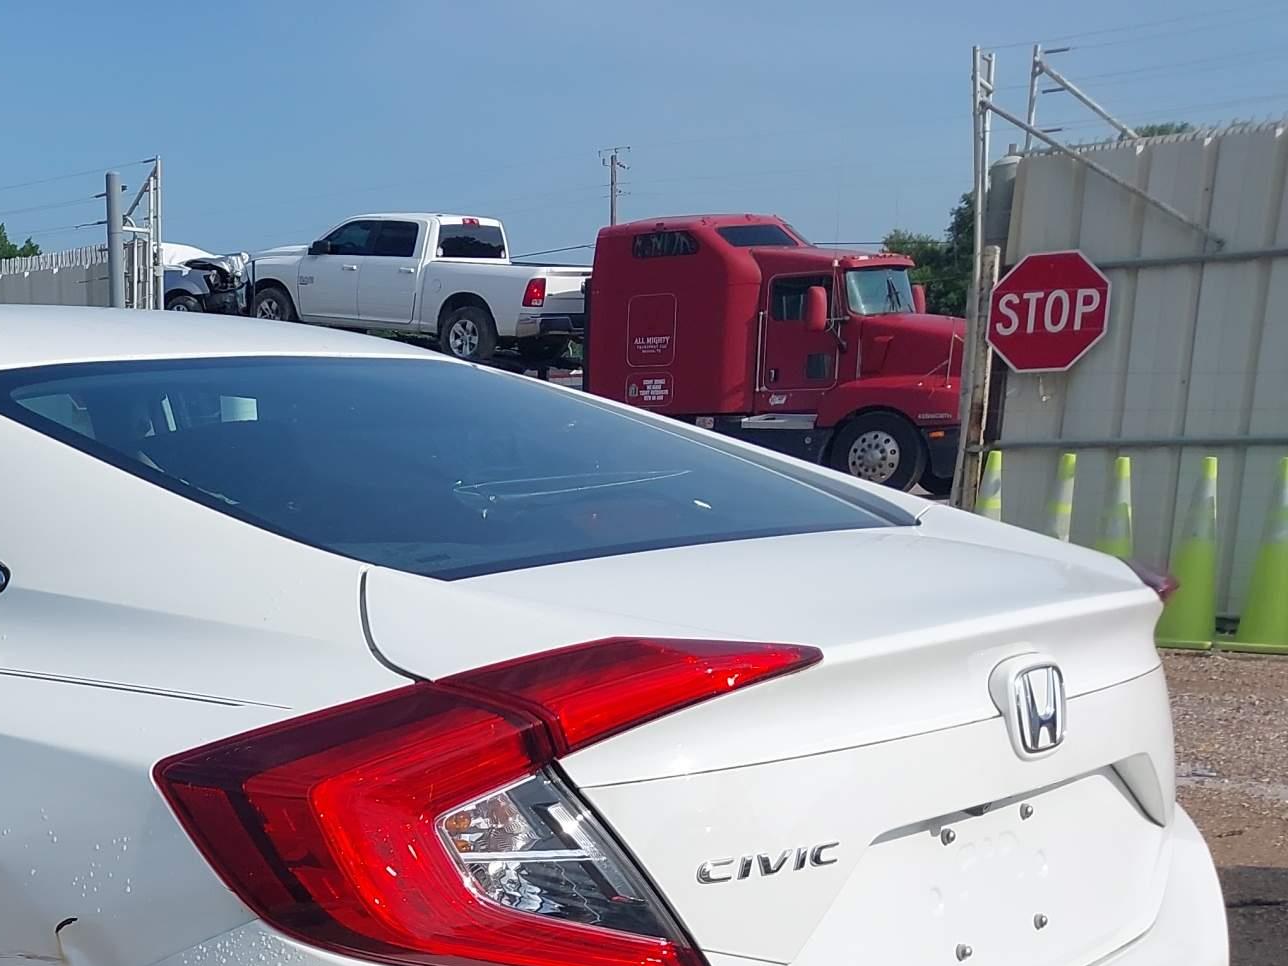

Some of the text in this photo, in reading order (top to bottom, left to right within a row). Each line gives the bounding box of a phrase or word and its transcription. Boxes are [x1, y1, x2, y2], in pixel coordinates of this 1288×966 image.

[996, 288, 1100, 335] STOP
[646, 336, 670, 344] MIGHTY
[697, 842, 839, 884] CIVIC
